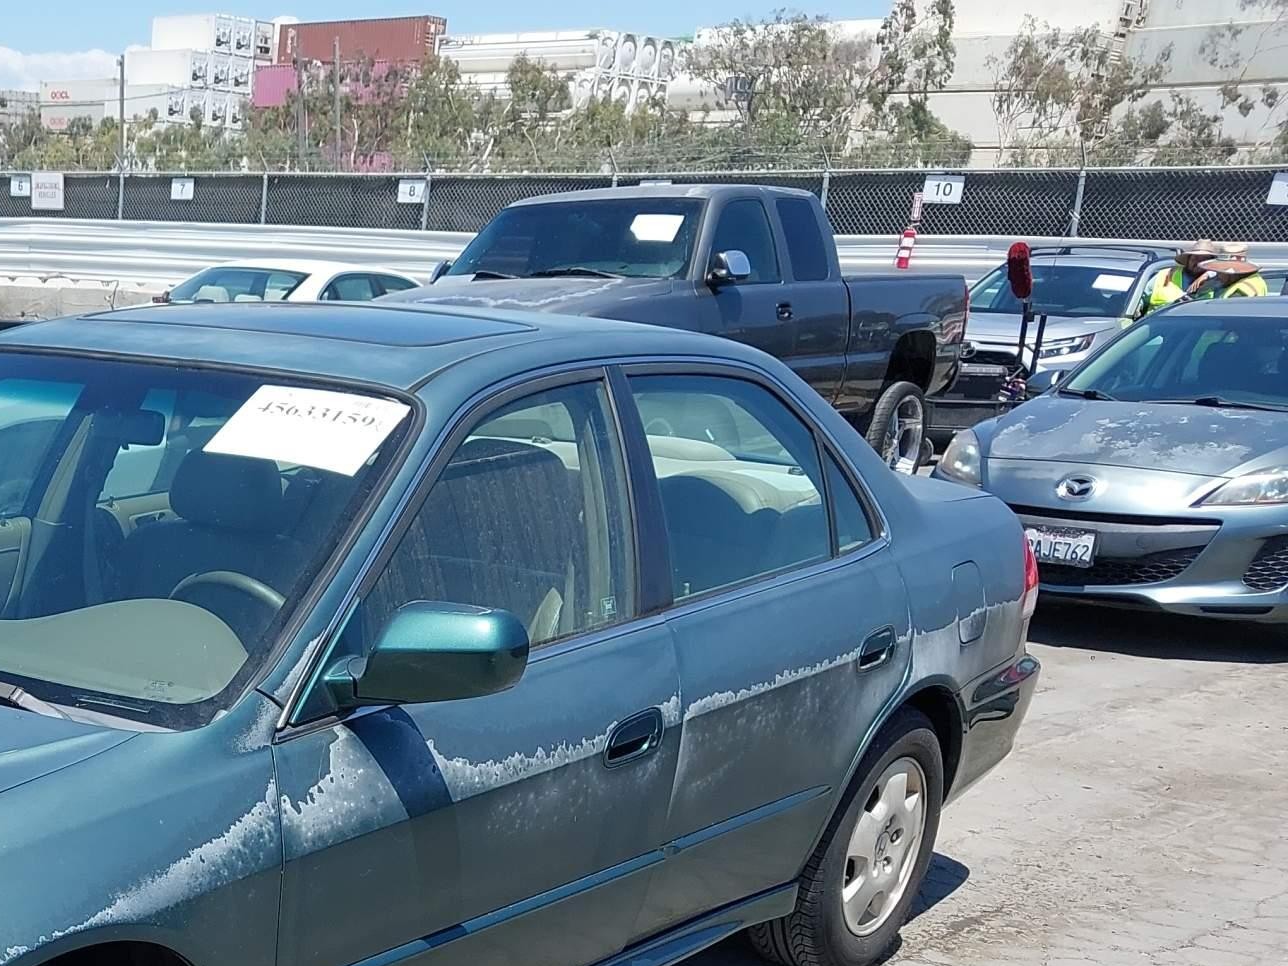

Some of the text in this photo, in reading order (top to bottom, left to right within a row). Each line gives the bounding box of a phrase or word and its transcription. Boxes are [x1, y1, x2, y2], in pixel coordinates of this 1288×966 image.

[180, 183, 186, 194] 7
[408, 185, 416, 197] 8
[935, 182, 953, 197] 10
[257, 401, 376, 427] 45633159
